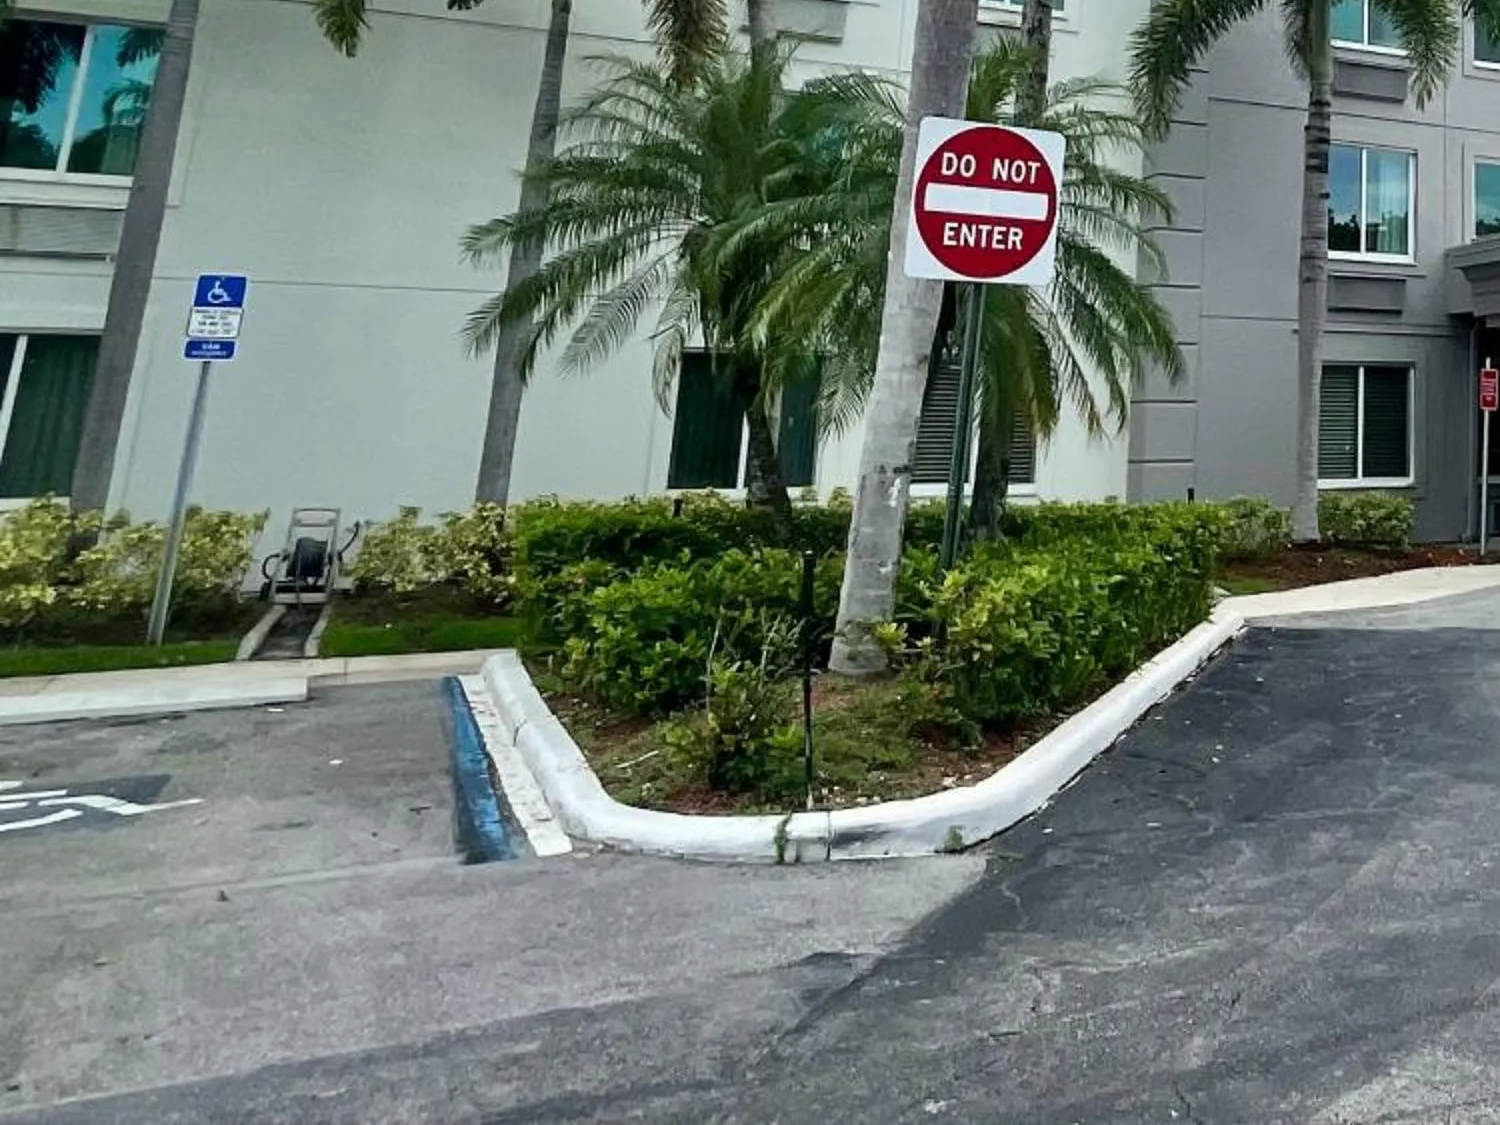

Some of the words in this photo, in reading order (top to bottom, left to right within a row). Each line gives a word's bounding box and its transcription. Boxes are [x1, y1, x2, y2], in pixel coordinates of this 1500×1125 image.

[940, 151, 977, 178] DO
[992, 157, 1041, 185] NOT
[943, 221, 1024, 251] ENTER
